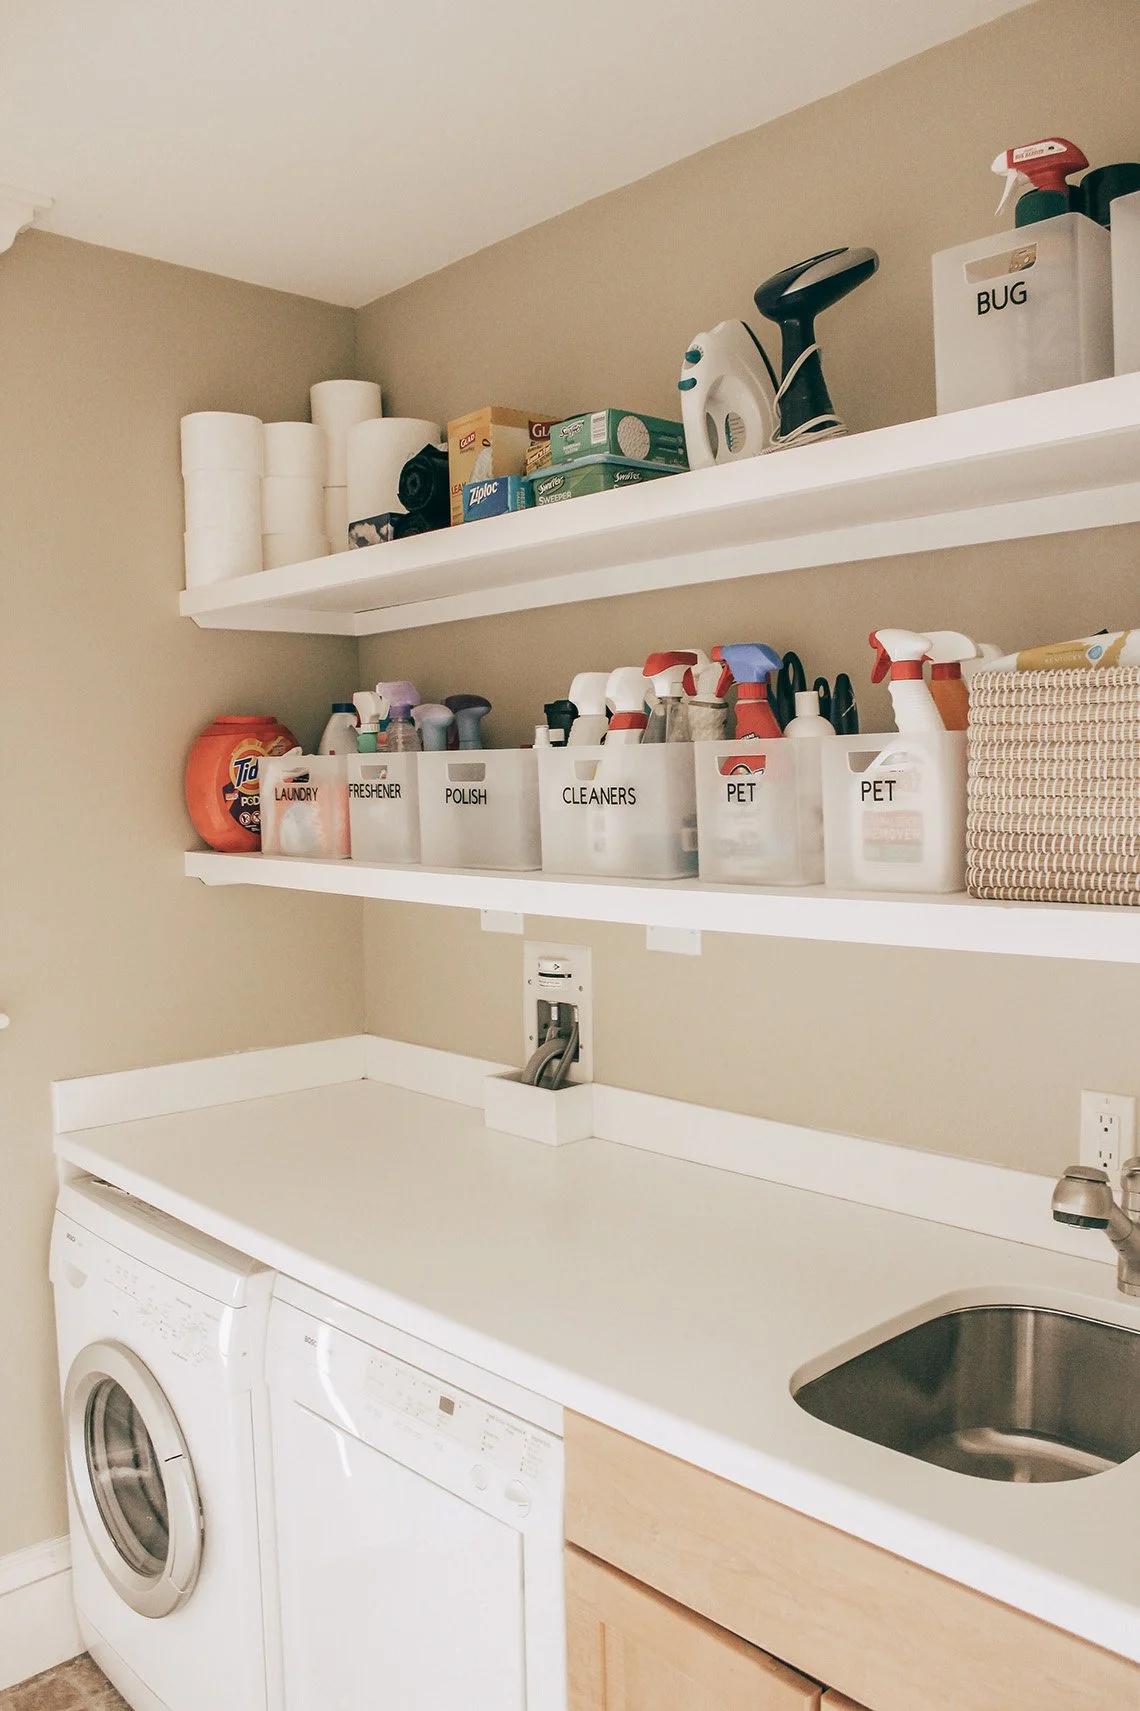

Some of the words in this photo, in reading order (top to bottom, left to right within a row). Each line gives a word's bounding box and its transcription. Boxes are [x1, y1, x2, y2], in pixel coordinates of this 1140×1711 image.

[977, 281, 1028, 315] BUG
[532, 423, 551, 438] GL
[460, 432, 475, 448] GLAD
[469, 481, 499, 507] Ziploc
[538, 491, 572, 506] SWEEPER
[233, 756, 260, 788] Tid
[274, 787, 319, 802] LAUNDRY
[348, 783, 402, 799] FRESHENER
[445, 788, 487, 805] POLISH
[562, 787, 637, 806] CLEANERS
[727, 782, 757, 802] PET
[861, 780, 897, 802] PET
[241, 795, 261, 807] POD
